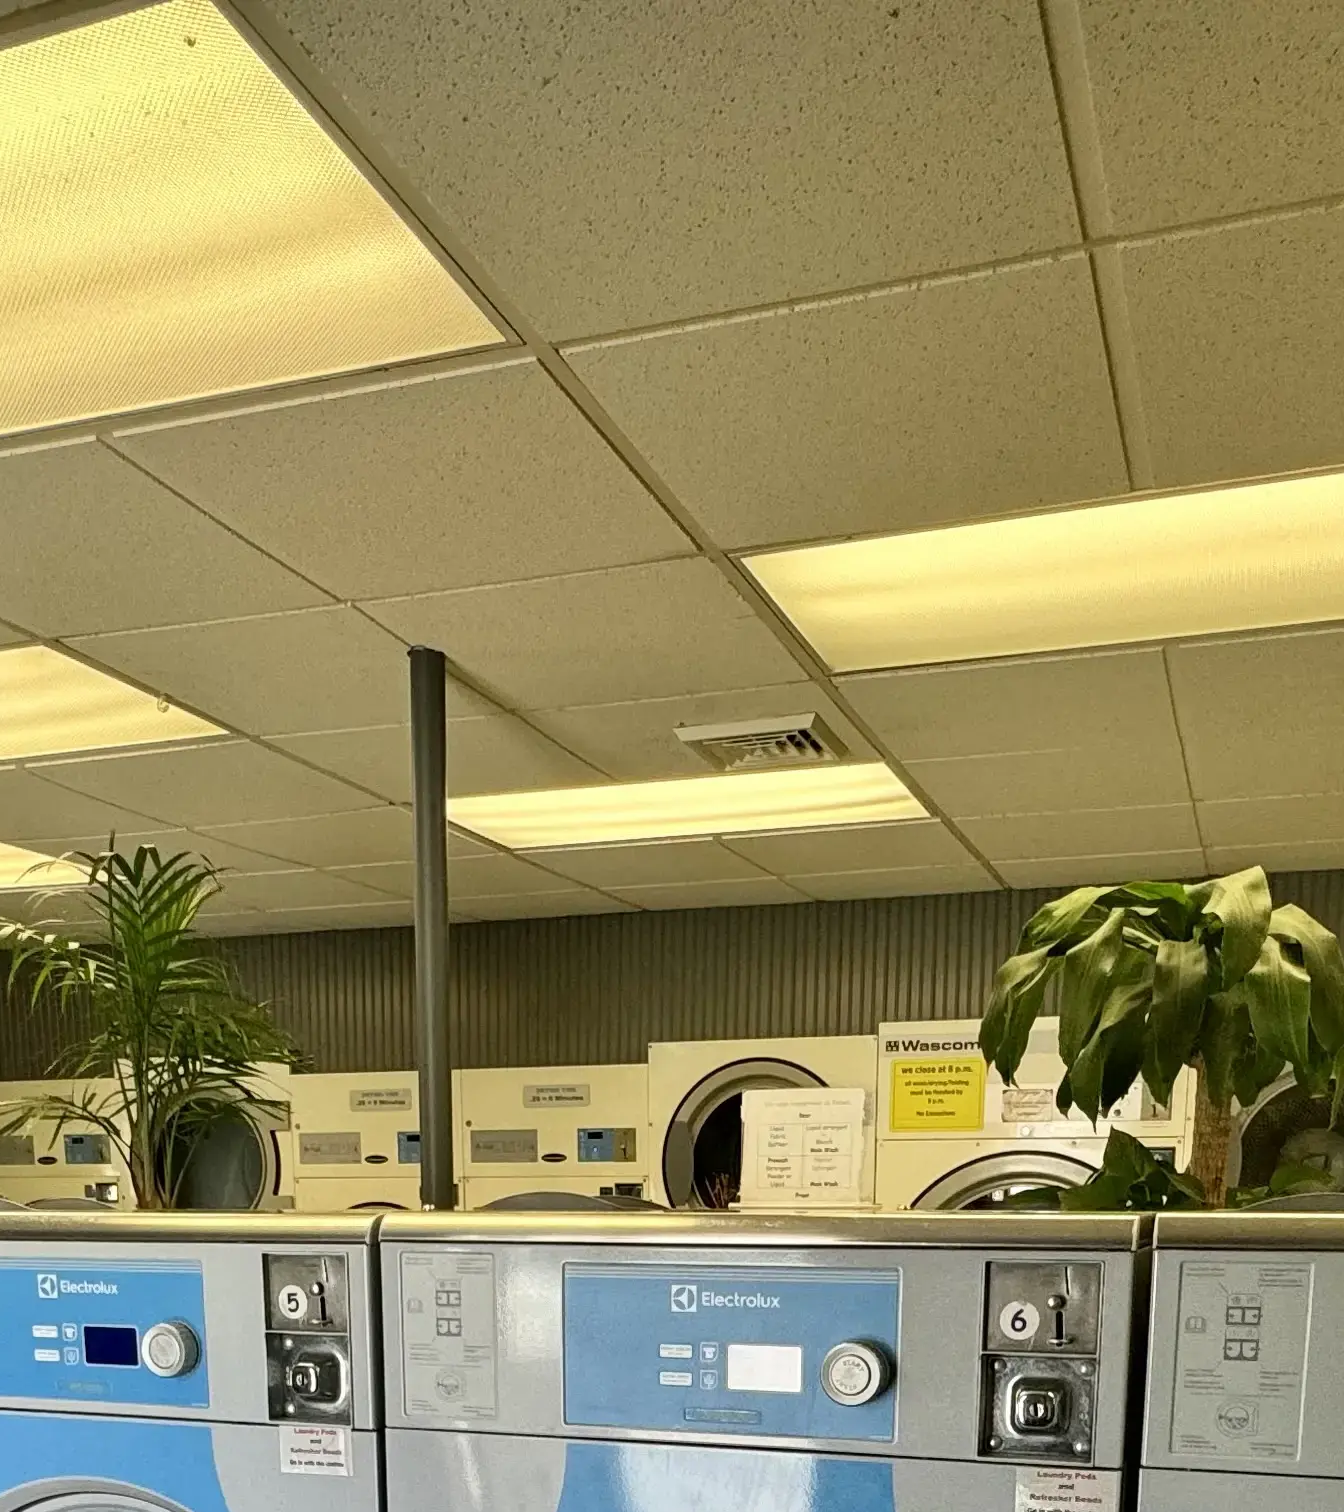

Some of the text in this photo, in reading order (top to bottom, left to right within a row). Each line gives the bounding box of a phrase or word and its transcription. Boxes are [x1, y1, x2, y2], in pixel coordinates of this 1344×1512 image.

[915, 1065, 936, 1074] close
[60, 1279, 119, 1295] Electrolux
[286, 1292, 300, 1313] 5
[701, 1291, 781, 1309] Electrolux
[1010, 1308, 1028, 1333] 6
[1037, 1471, 1073, 1481] Laundry
